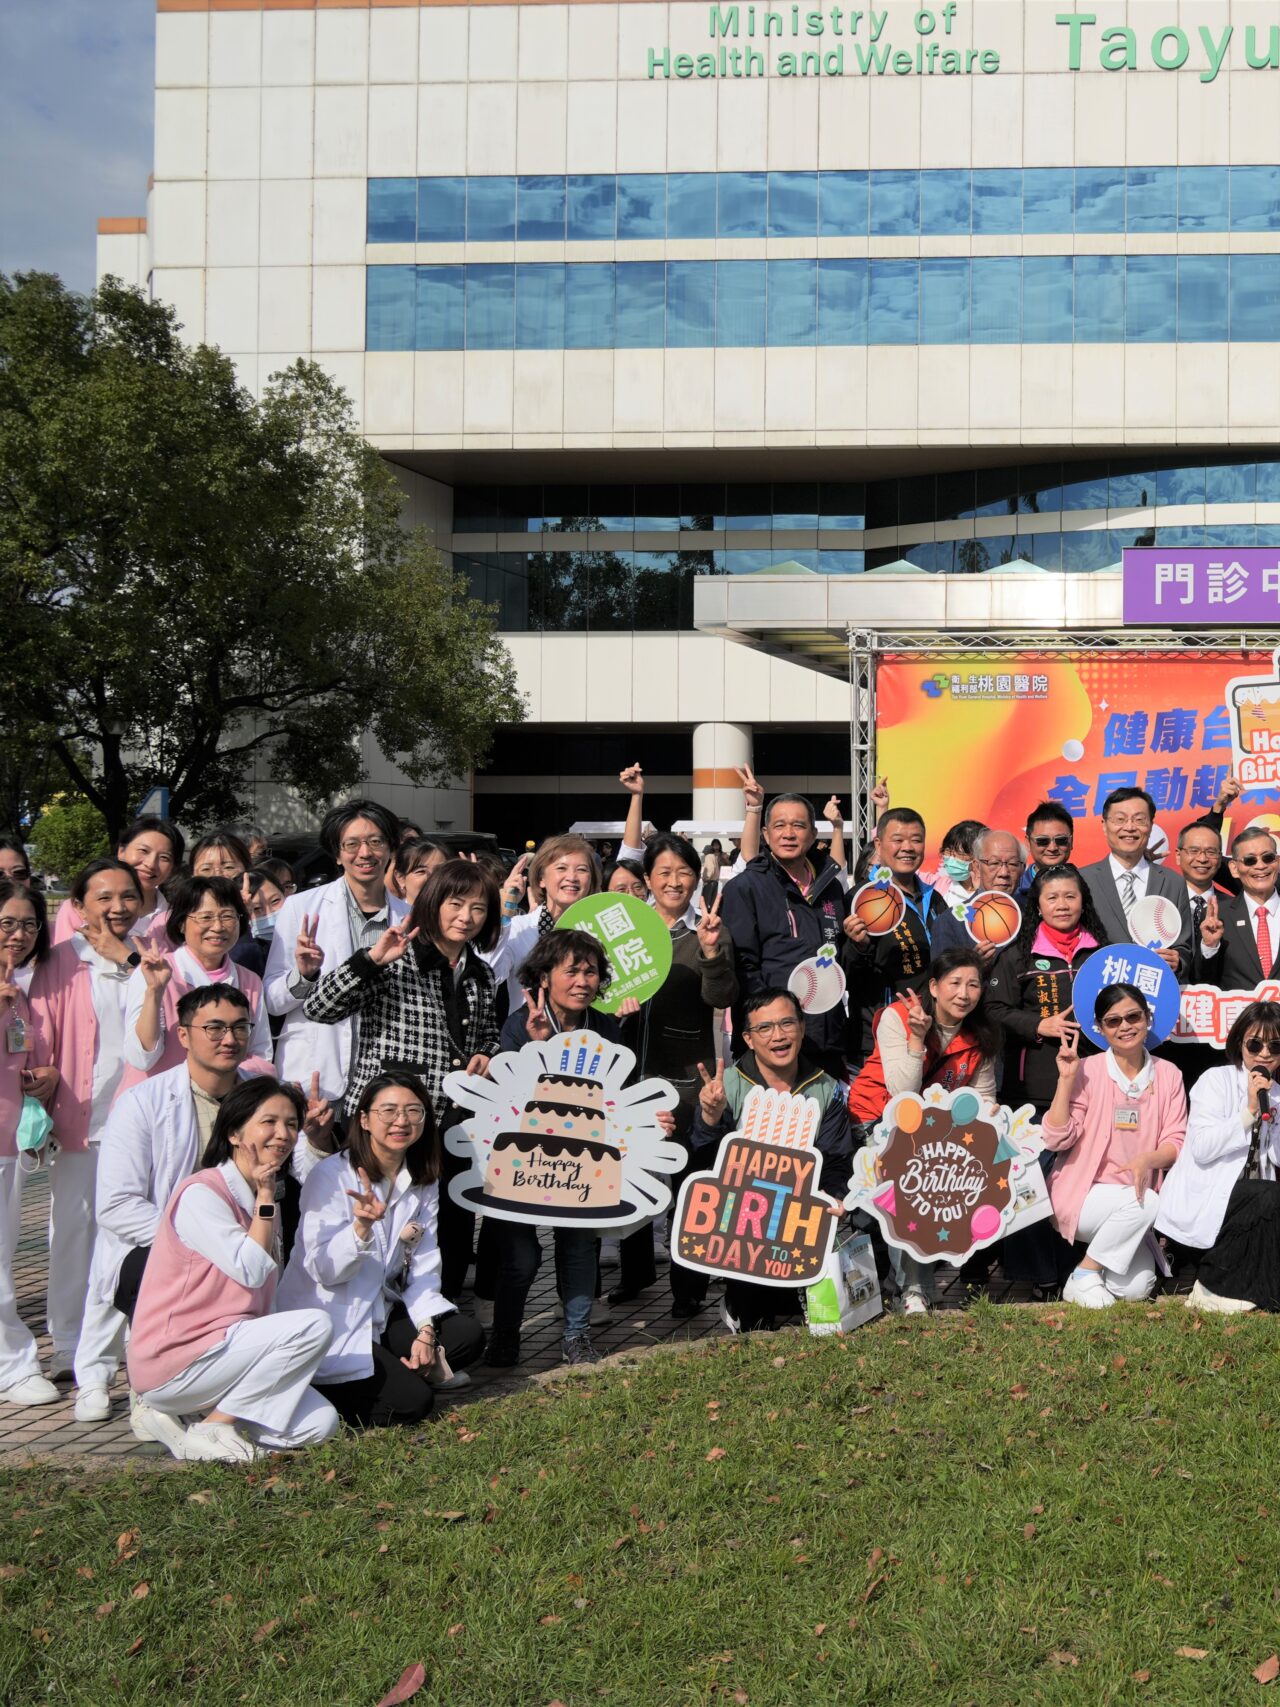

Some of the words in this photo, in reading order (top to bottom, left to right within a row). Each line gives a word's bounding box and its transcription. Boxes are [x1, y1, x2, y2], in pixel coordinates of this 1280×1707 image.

[708, 5, 888, 38] Ministry
[913, 2, 957, 35] of
[647, 46, 765, 79] Health
[777, 45, 844, 77] and
[858, 42, 1000, 76] Welfare
[978, 674, 1048, 692] 桃園醫院
[1102, 955, 1164, 998] 桃園
[526, 1151, 583, 1182] Happy
[722, 1144, 814, 1197] HAPPY
[921, 1141, 976, 1168] HAPPY
[512, 1170, 592, 1203] Birthday
[899, 1158, 988, 1207] Birthday
[683, 1178, 823, 1247] BIRTH
[911, 1193, 931, 1216] TO
[932, 1203, 963, 1223] YOU
[704, 1235, 765, 1272] DAY
[764, 1259, 792, 1278] YOU
[771, 1245, 788, 1262] TO
